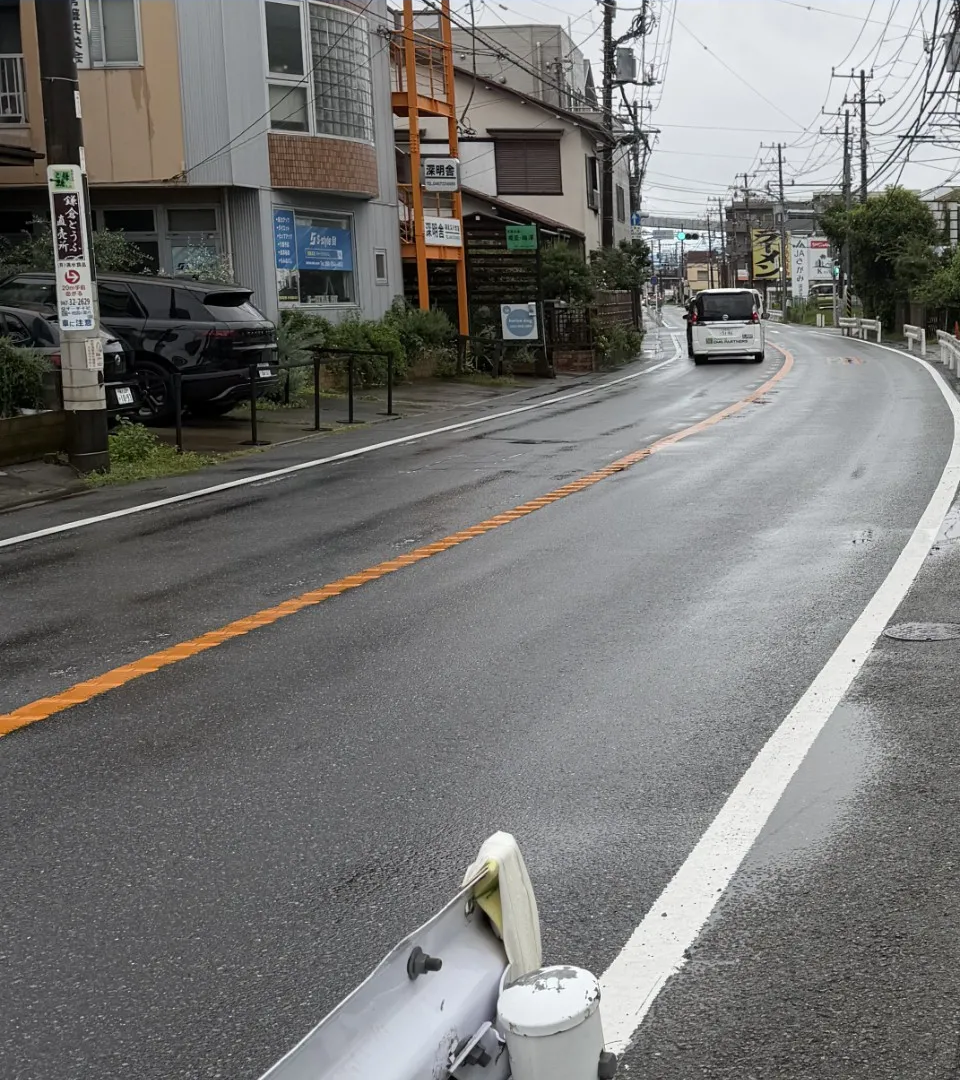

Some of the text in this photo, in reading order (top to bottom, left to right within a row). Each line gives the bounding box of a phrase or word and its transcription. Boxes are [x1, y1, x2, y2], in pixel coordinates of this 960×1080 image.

[63, 195, 82, 253] 鎌倉とうふ
[754, 230, 780, 277] ラーメン
